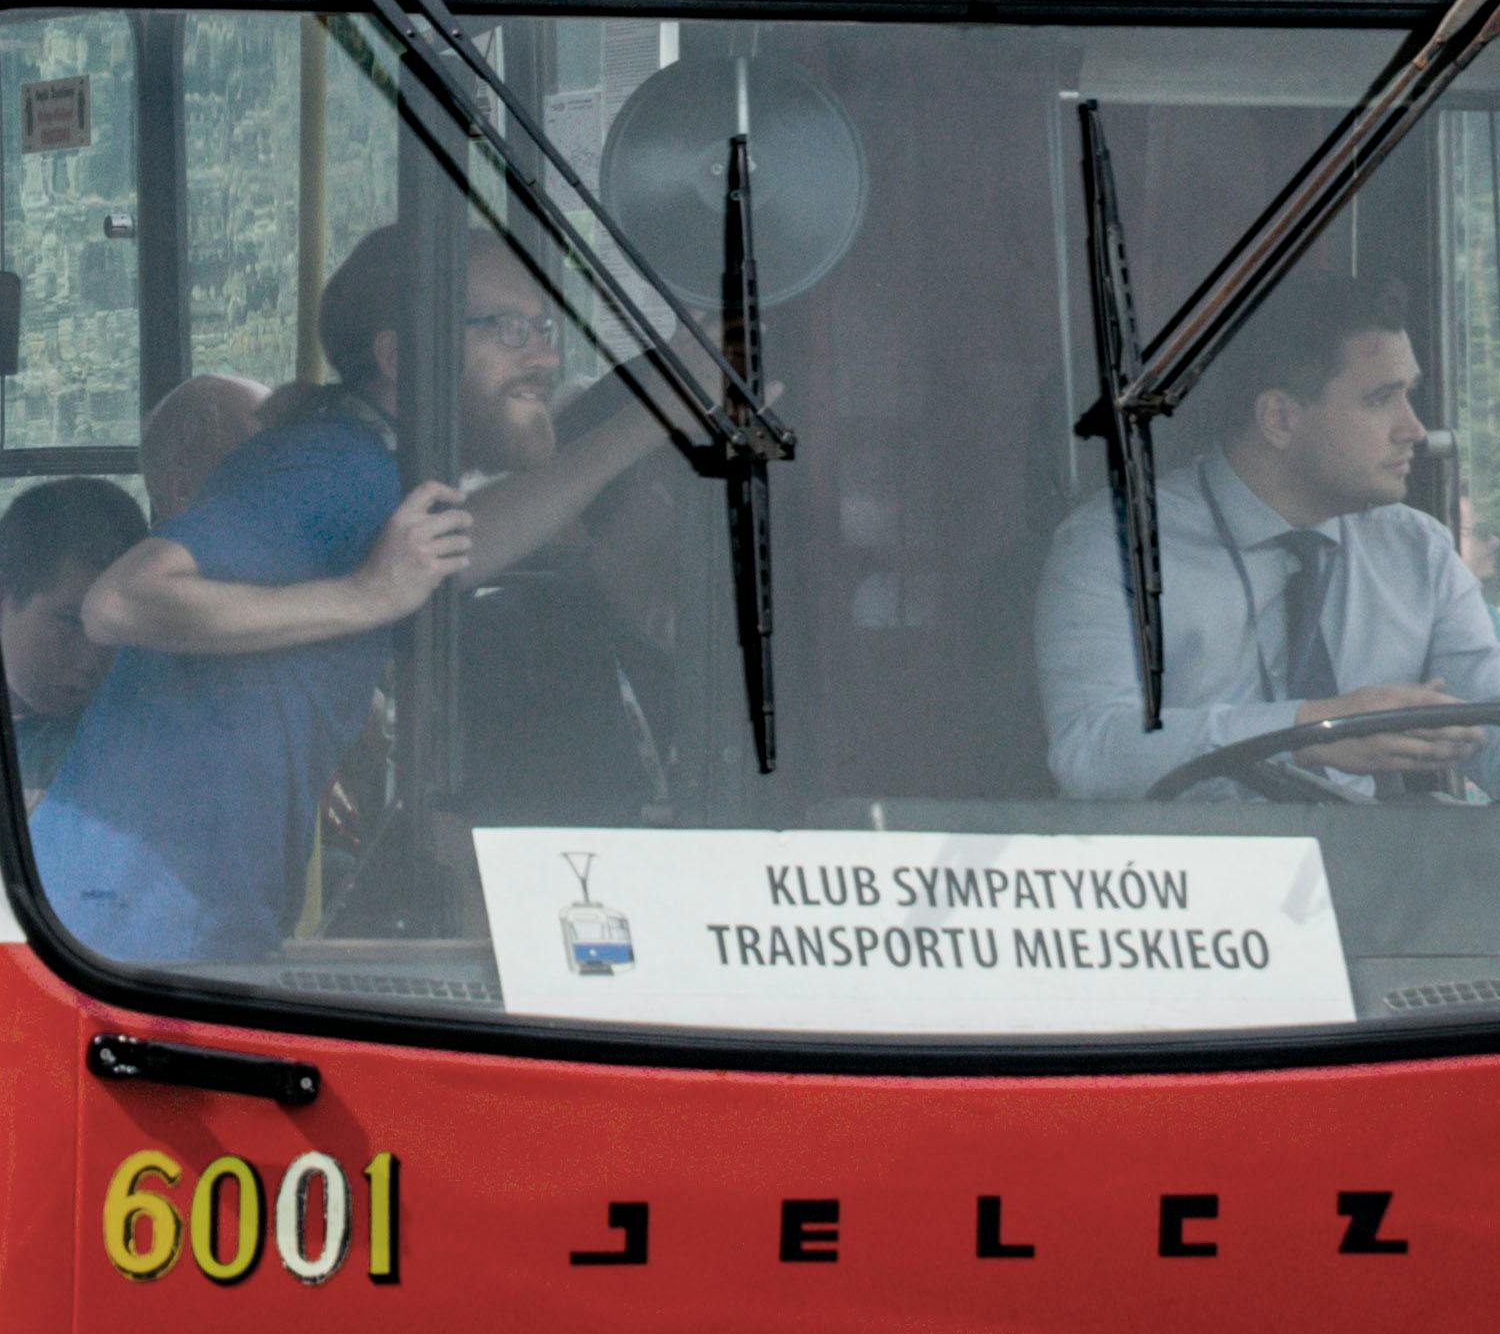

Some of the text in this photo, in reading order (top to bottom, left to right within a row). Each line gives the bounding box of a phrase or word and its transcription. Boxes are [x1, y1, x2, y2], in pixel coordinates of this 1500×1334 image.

[767, 860, 1191, 911] KLUB SYMPATYKÓW
[707, 923, 1271, 972] TRANSPORTU MIEJSKIEGO
[103, 1148, 400, 1288] 6001
